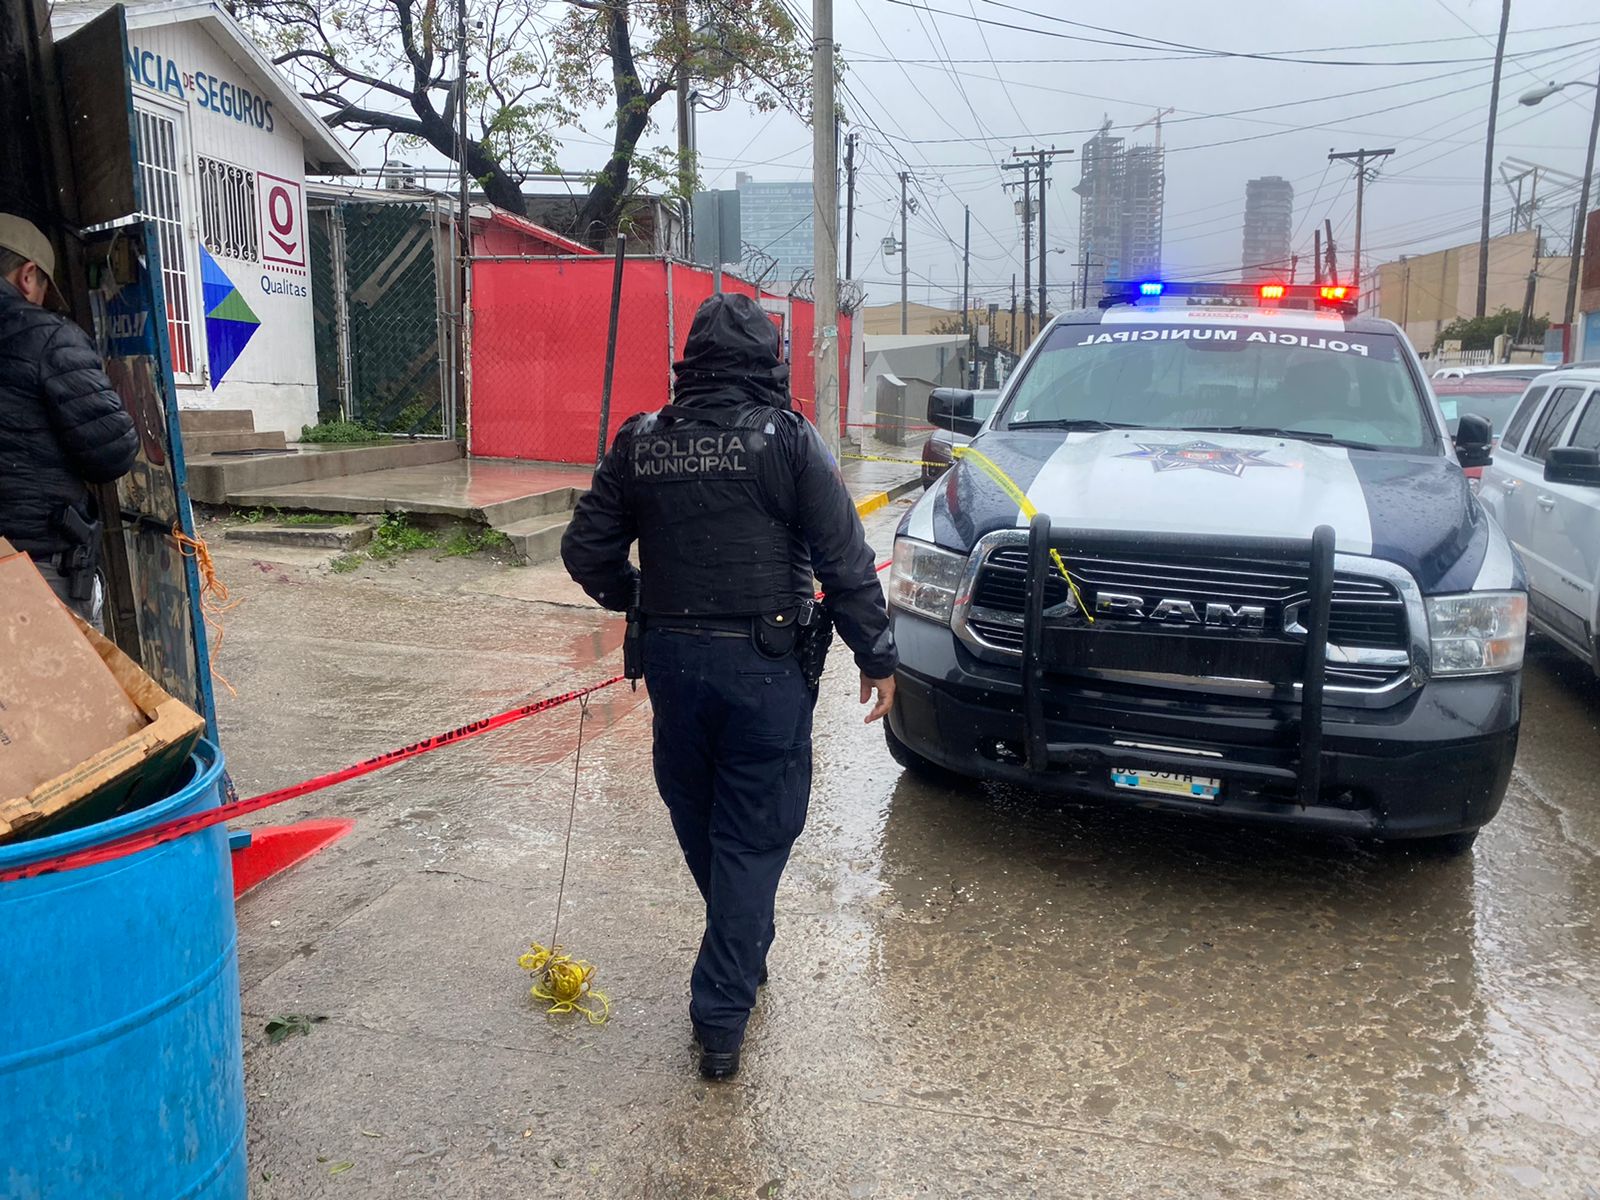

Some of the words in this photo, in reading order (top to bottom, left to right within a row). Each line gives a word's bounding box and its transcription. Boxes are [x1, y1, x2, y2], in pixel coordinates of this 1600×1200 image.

[183, 72, 195, 91] DE
[195, 71, 274, 133] SEGUROS
[260, 275, 307, 298] Qualitas
[634, 433, 746, 460] POLICÍA
[634, 455, 747, 477] MUNICIPAL
[1096, 591, 1266, 628] RAM
